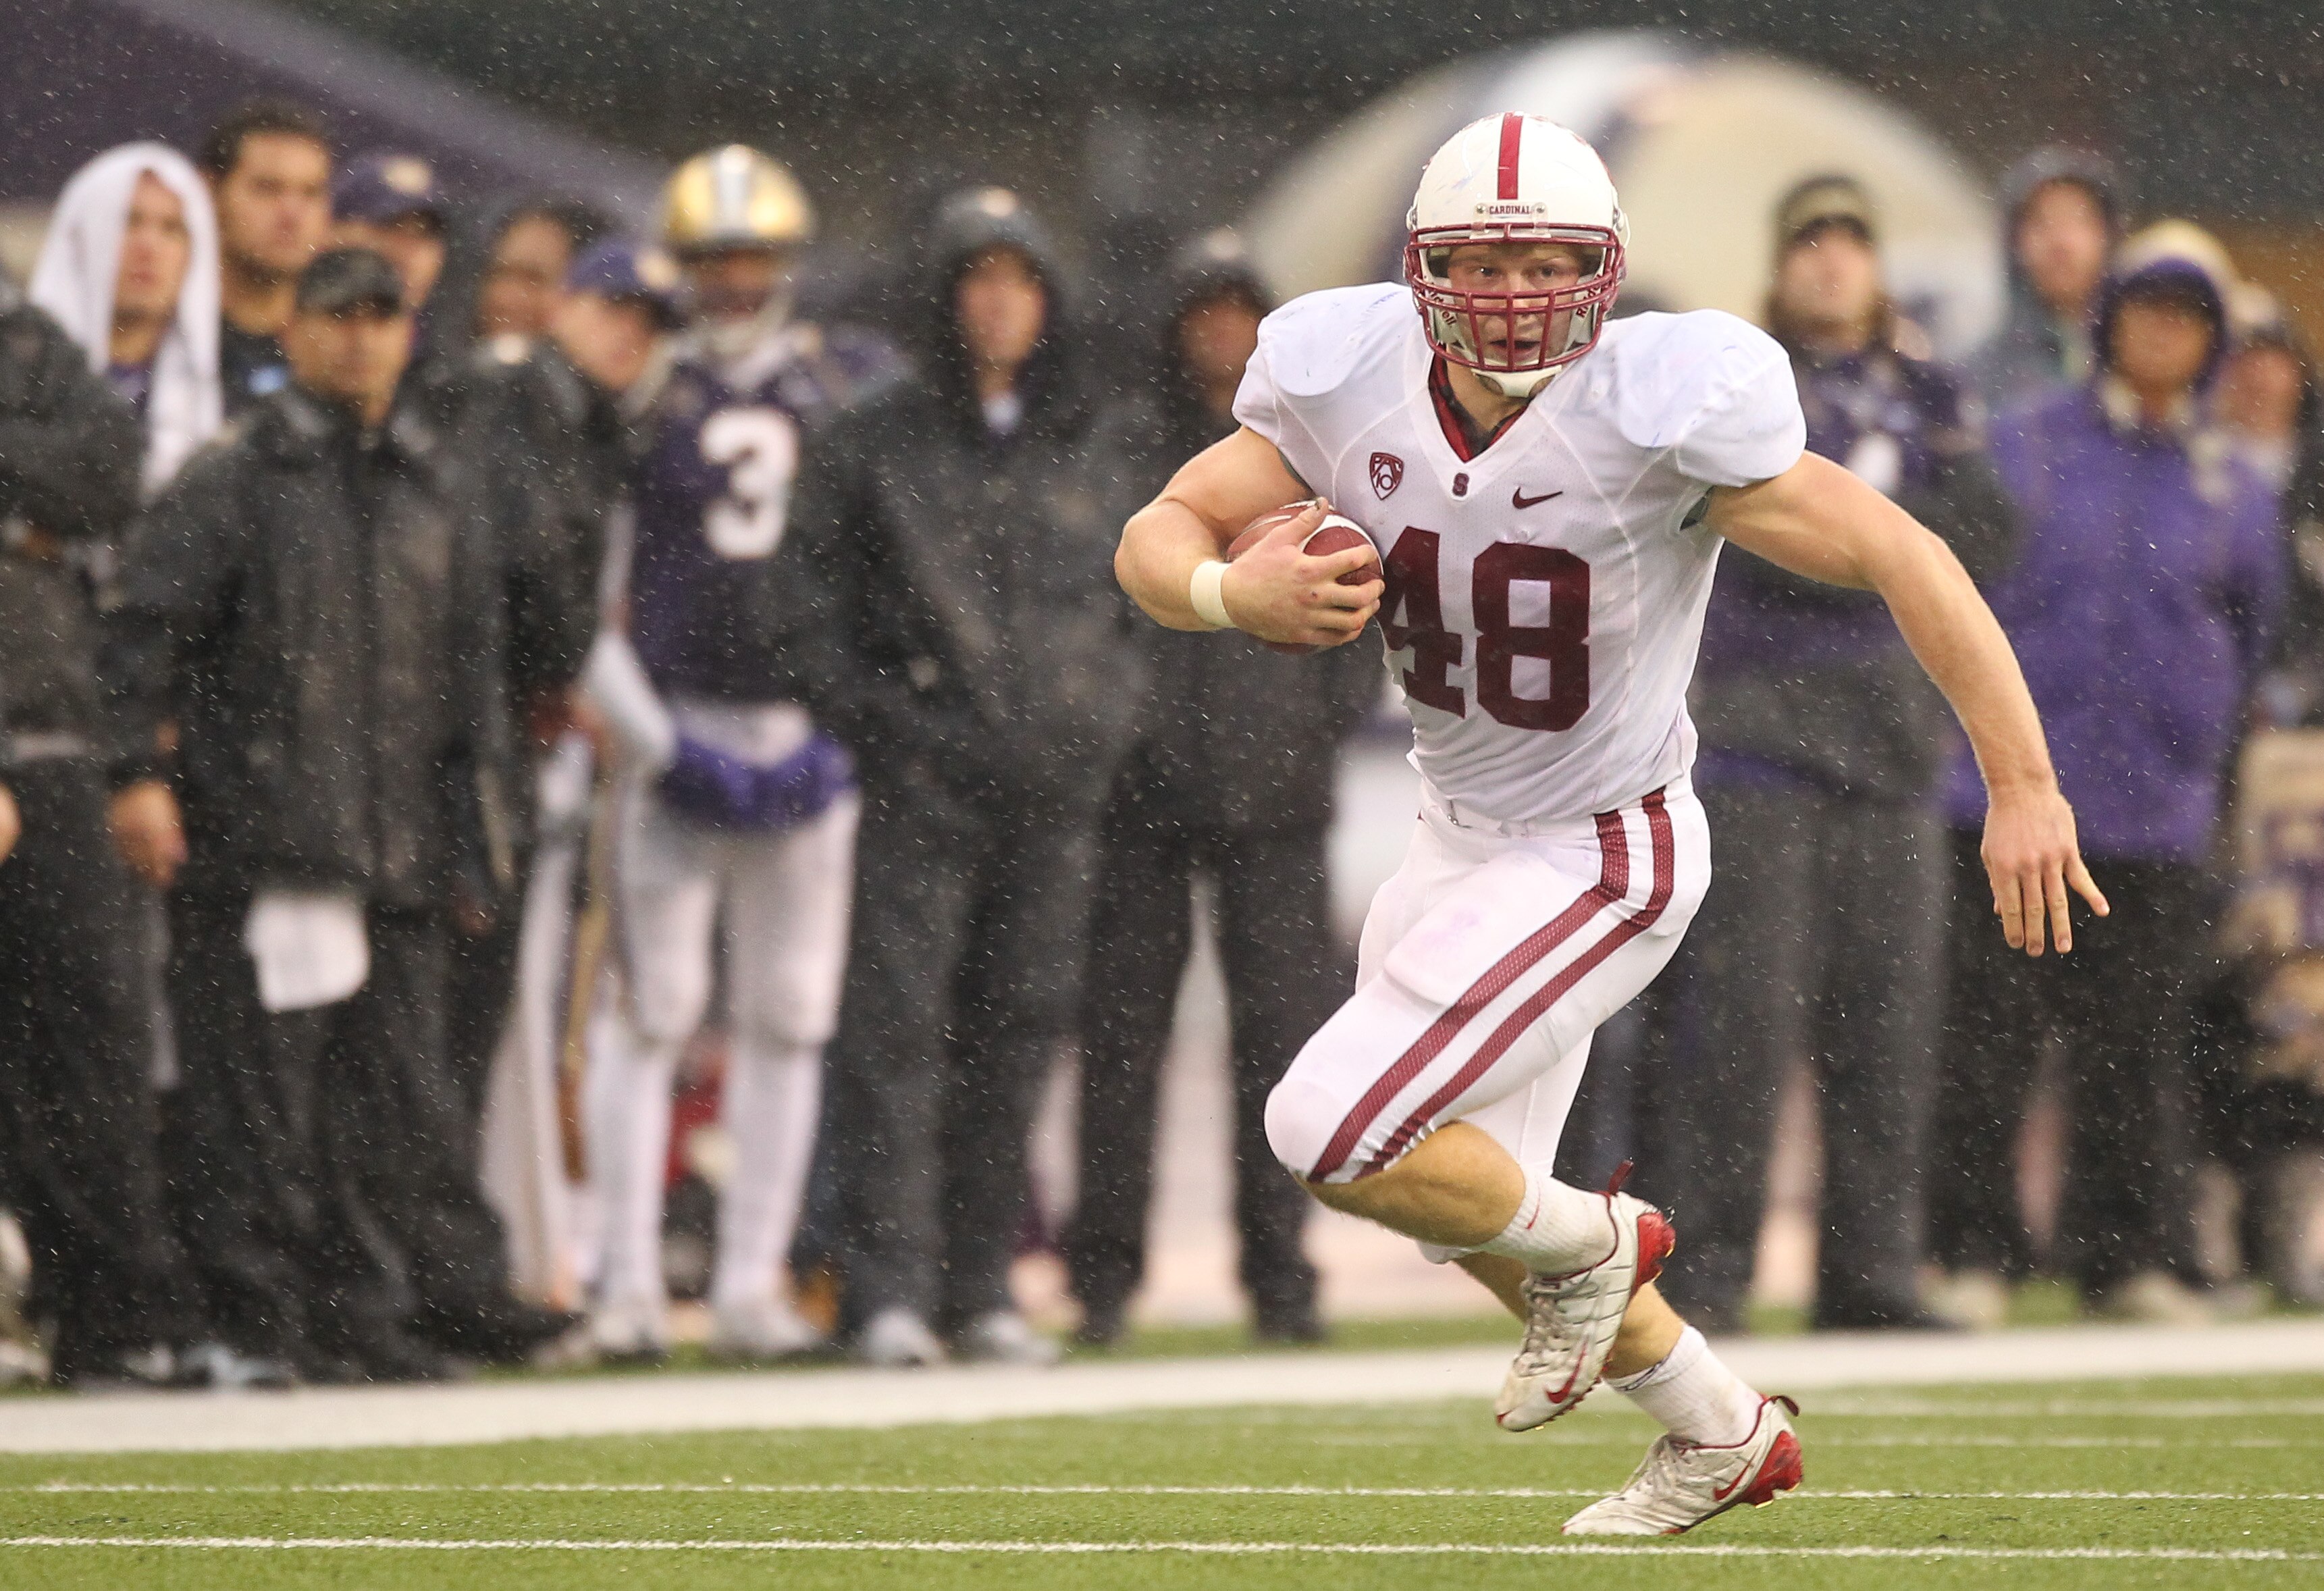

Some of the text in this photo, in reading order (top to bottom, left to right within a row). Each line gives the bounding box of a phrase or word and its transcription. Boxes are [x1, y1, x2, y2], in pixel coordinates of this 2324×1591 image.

[1489, 205, 1530, 215] CARDINAL
[699, 407, 799, 560] 3
[1375, 525, 1590, 732] 48
